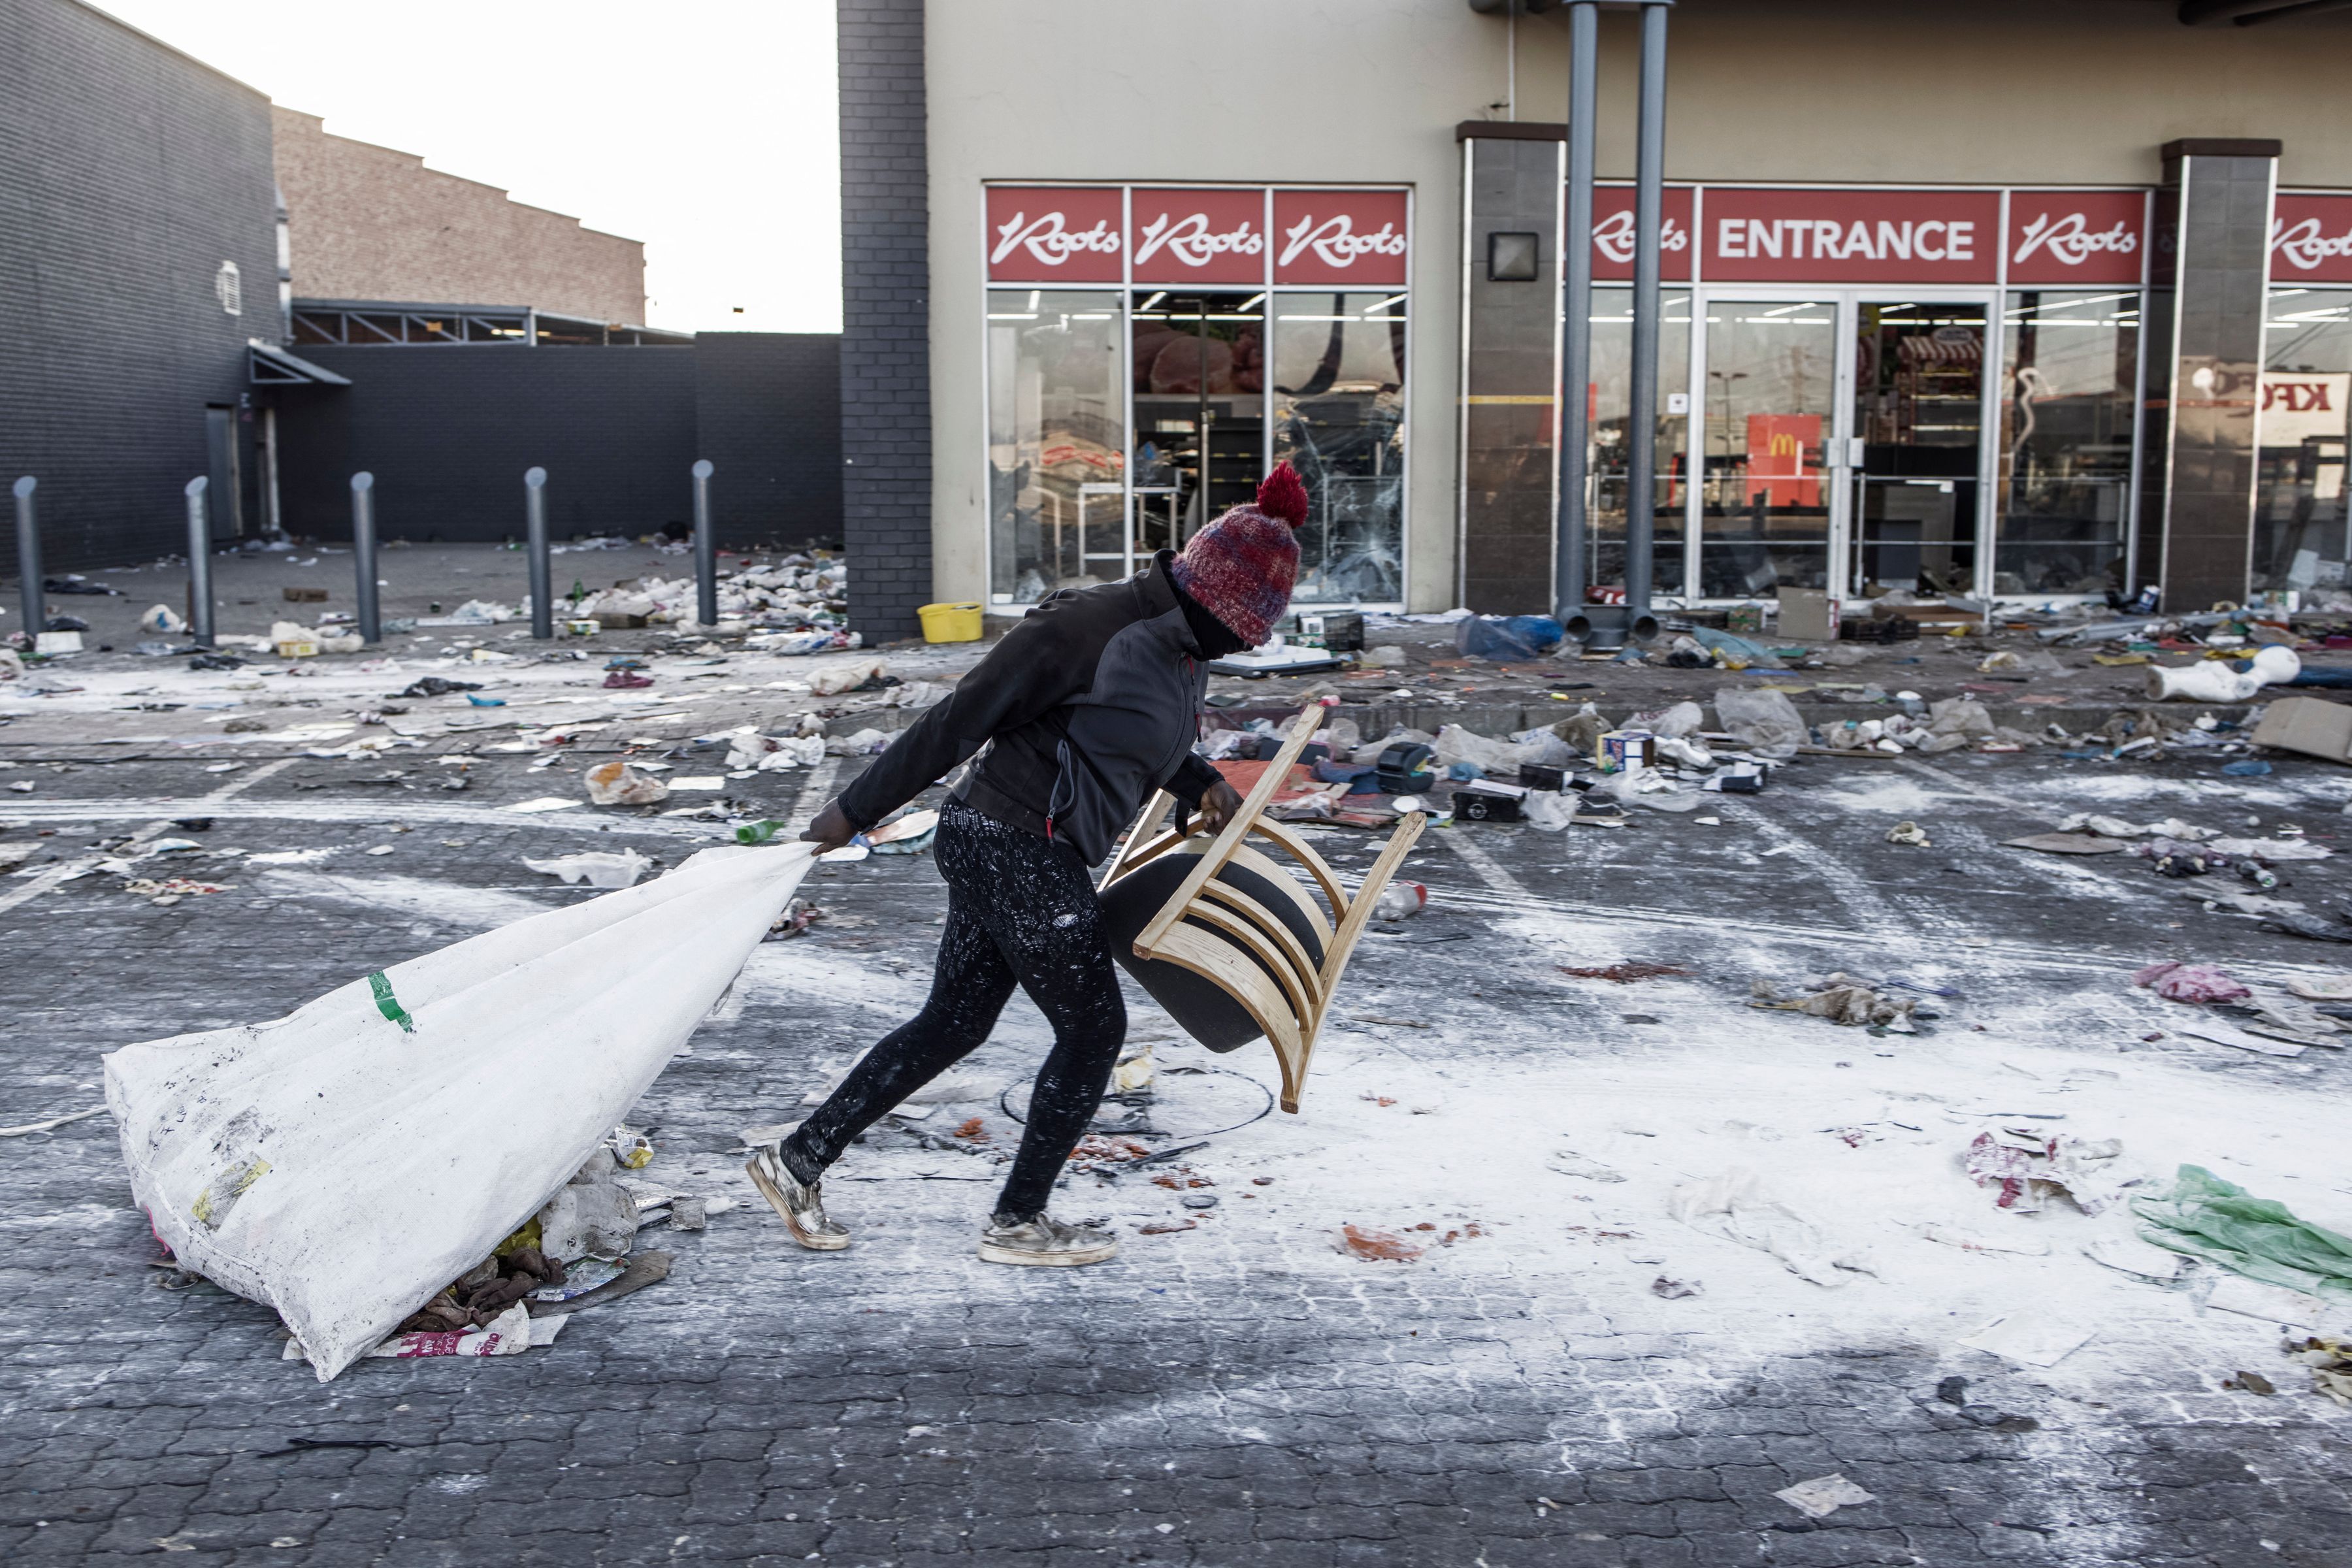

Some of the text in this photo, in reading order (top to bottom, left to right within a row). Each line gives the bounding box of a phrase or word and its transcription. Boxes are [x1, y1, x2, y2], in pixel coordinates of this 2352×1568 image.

[990, 211, 1121, 266] Roots
[1134, 213, 1264, 267] Roots
[1278, 214, 1406, 268] Roots
[1592, 210, 1688, 263] Rots
[1718, 219, 1974, 261] ENTRANCE
[2014, 213, 2136, 265] Roots
